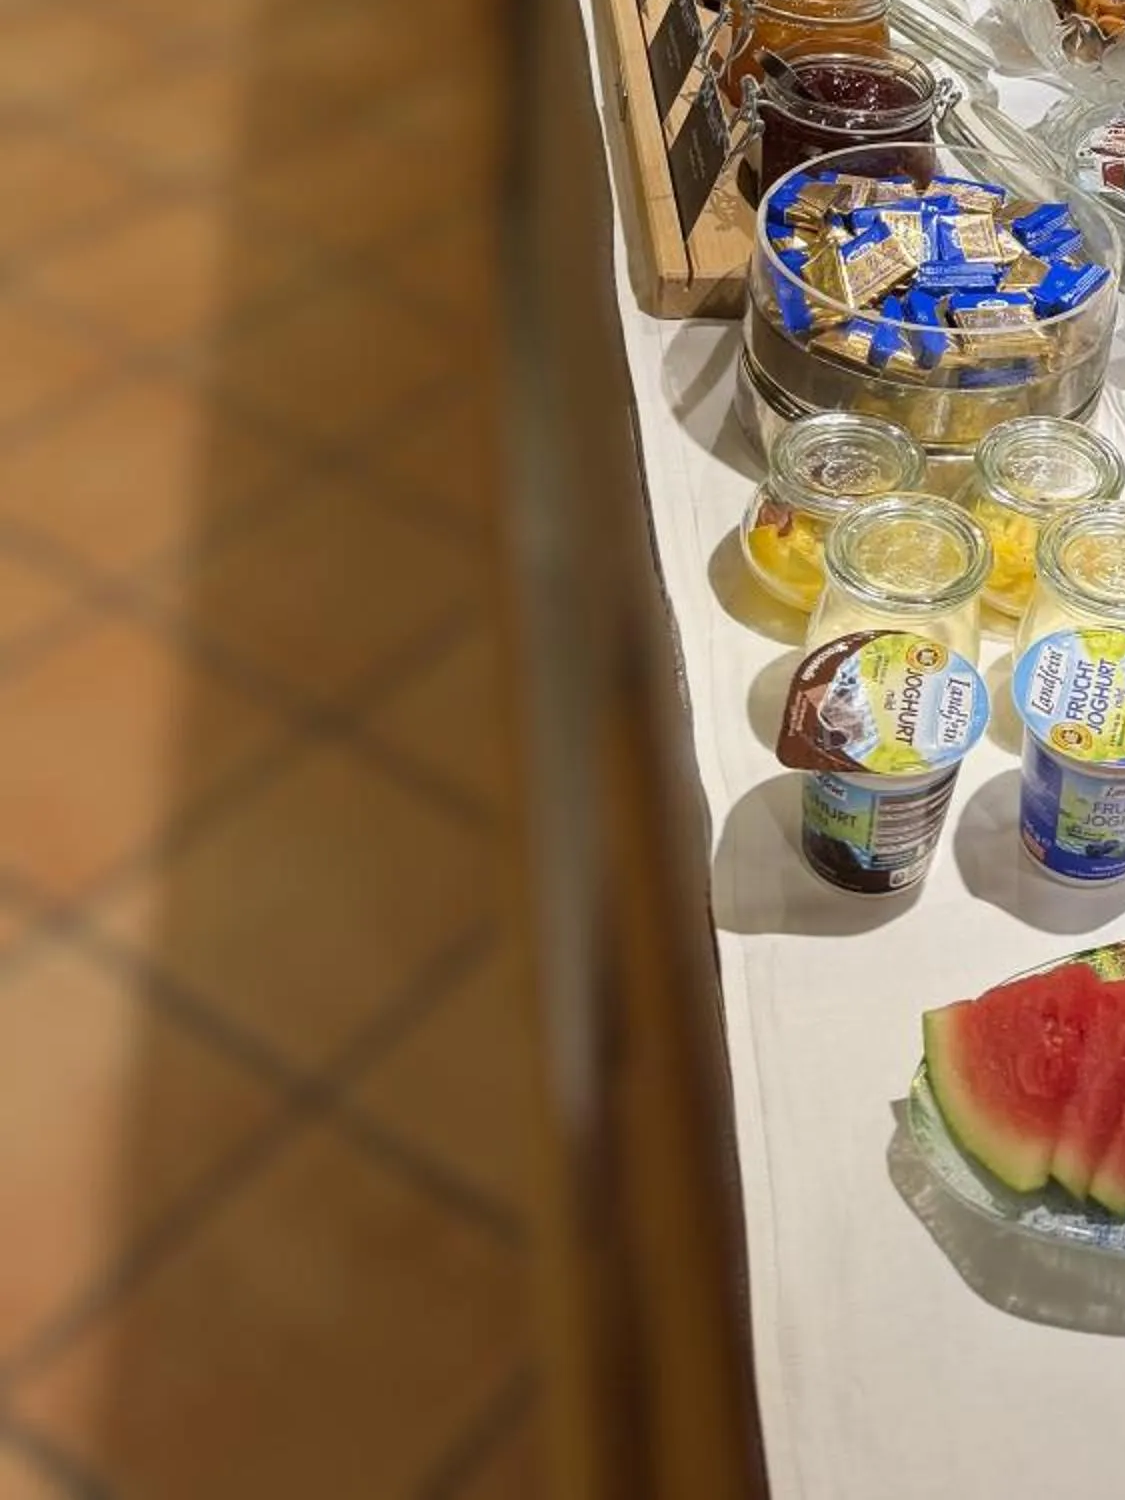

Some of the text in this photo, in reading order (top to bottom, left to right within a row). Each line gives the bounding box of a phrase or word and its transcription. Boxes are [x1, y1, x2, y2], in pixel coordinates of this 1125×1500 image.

[895, 667, 923, 746] JOGHURT
[939, 677, 971, 744] Landfein
[1032, 645, 1063, 715] Landfein
[1066, 660, 1094, 721] FRUCHT
[1087, 658, 1118, 734] JOGHURT
